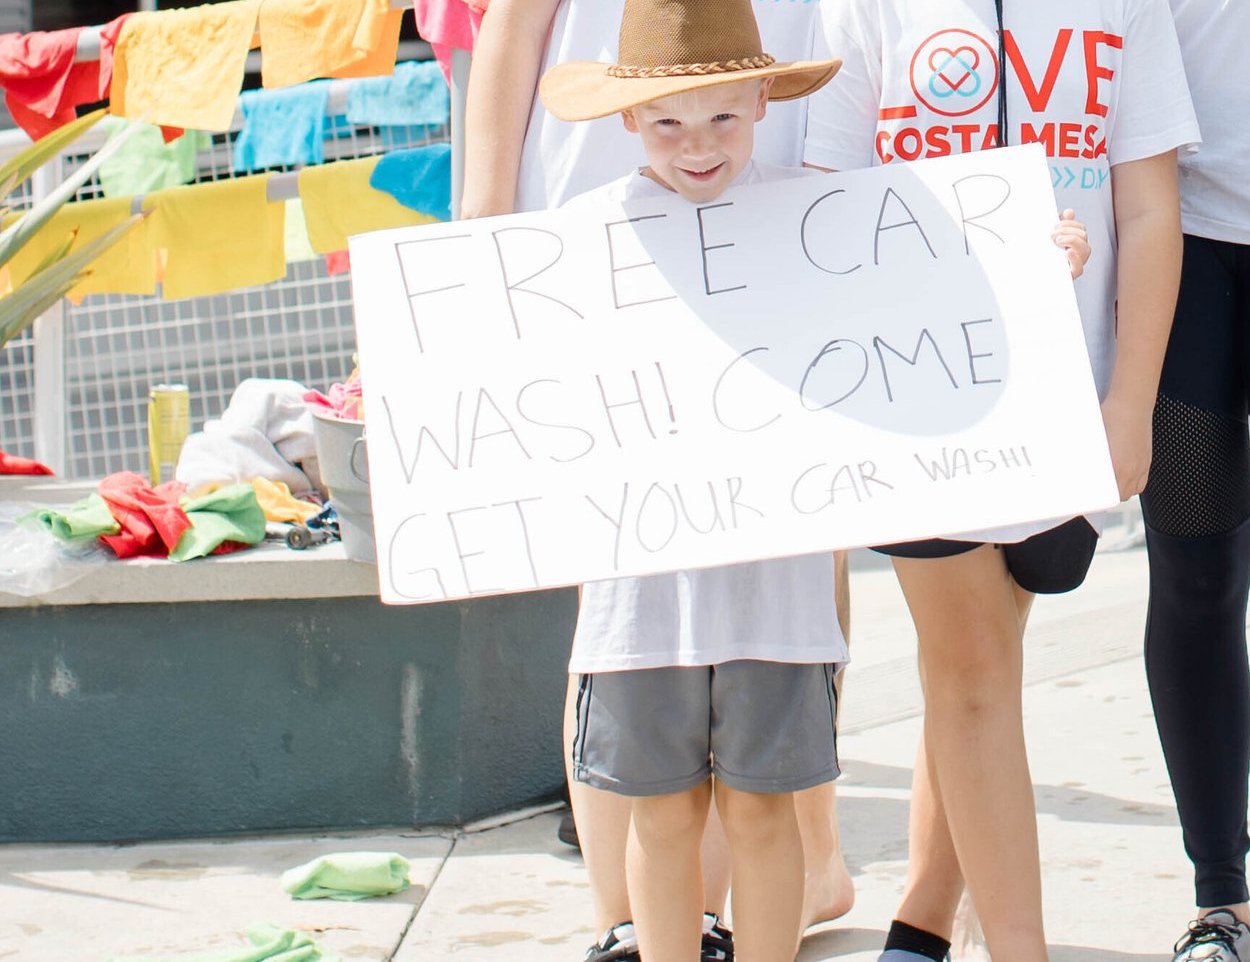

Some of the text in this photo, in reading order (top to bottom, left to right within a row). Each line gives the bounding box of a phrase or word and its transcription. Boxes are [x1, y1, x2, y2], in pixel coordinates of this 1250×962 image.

[394, 173, 1011, 355] FREE CAR
[381, 318, 1002, 485] WASH! COME
[388, 496, 543, 600] GET
[584, 476, 765, 572] YOUR
[790, 459, 895, 515] CAR
